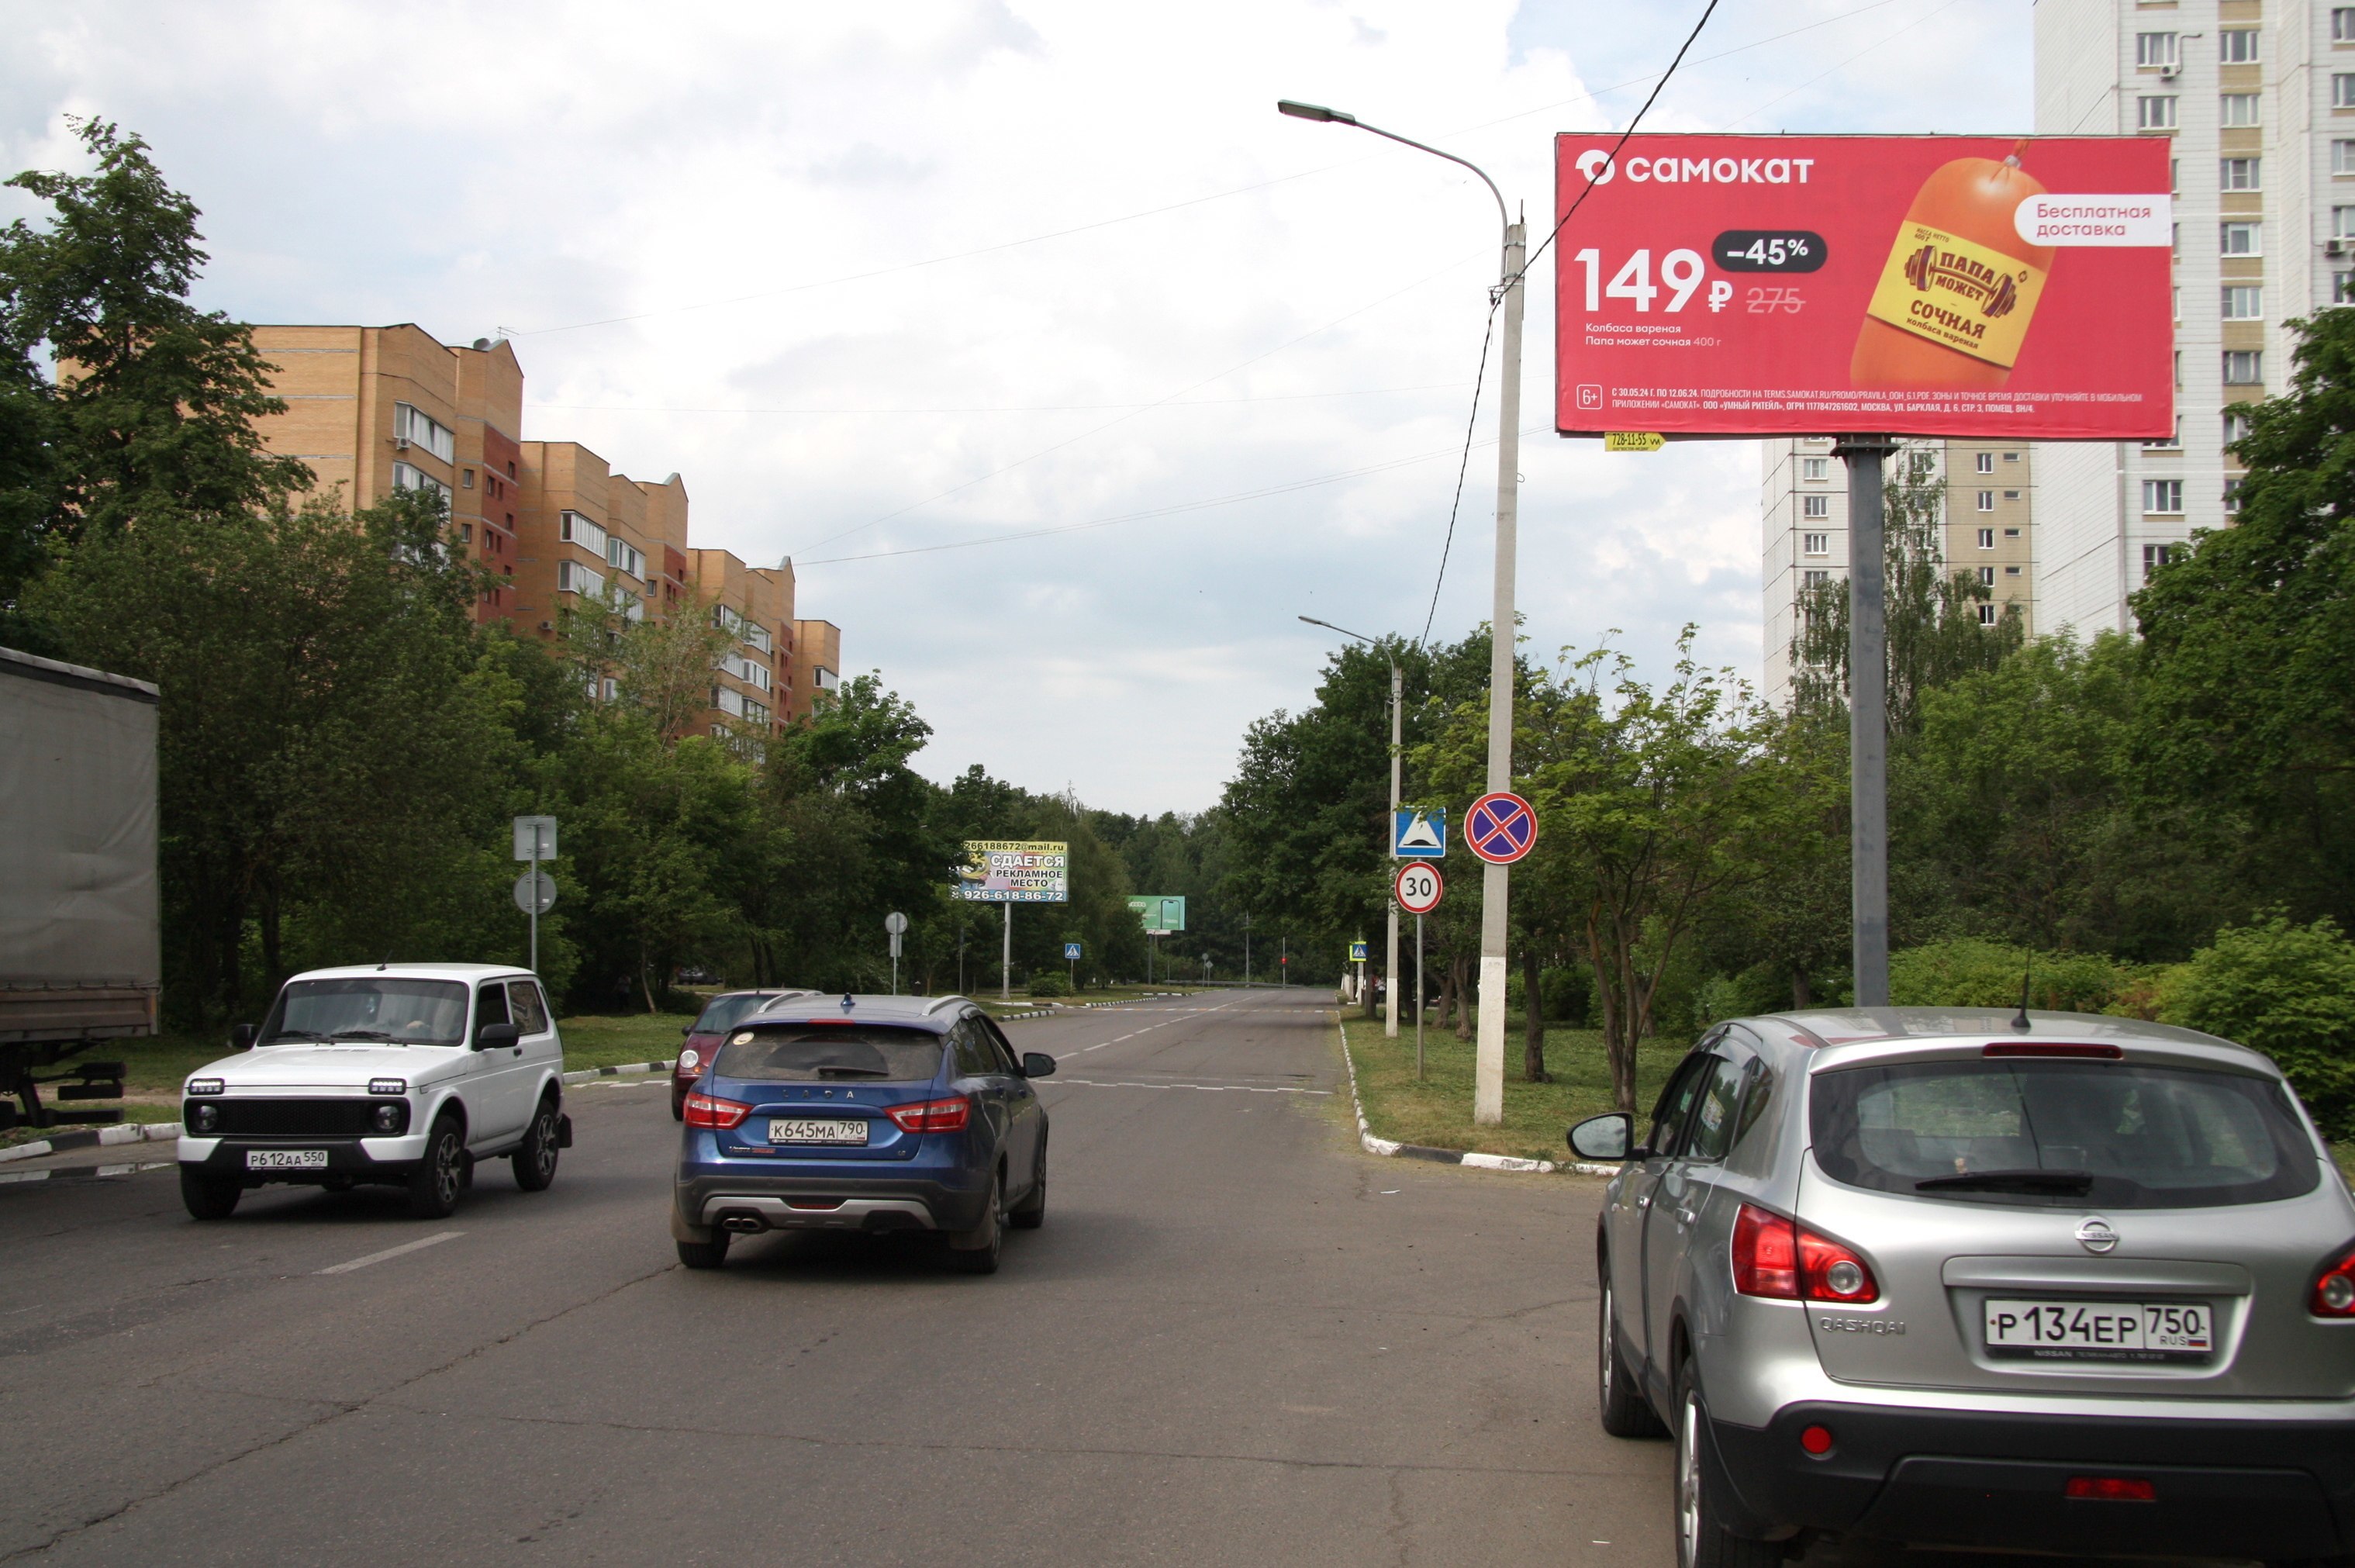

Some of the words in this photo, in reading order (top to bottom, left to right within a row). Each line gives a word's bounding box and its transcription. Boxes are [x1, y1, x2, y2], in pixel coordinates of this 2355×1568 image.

[2037, 203, 2151, 219] Бесплатная
[2036, 223, 2126, 238] доставка
[1939, 252, 1995, 285] ПАПА
[1935, 275, 1984, 302] МОЖЕТ
[1746, 287, 1806, 314] 275
[1911, 299, 1987, 340] СОЧНАЯ
[1585, 323, 1633, 333] Колбаса
[1635, 325, 1681, 334] вареная
[1906, 317, 1942, 336] колбаса
[1942, 331, 1979, 350] вареная
[1585, 336, 1614, 346] Папа
[1617, 337, 1650, 346] может
[1652, 338, 1691, 347] сочная
[1693, 337, 1714, 347] 400
[1582, 389, 1598, 405] 6+
[1611, 388, 1617, 396] С
[1618, 388, 1649, 397] 30.05.24
[1656, 389, 1667, 397] ПО
[1669, 389, 1699, 398] 12.06.24.
[1701, 389, 1751, 399] ПОДРОБНОСТИ
[1752, 390, 1763, 399] НА
[1932, 392, 1953, 400] ЗОНЫ
[1953, 392, 1960, 400] И
[1961, 392, 1987, 401] ТОЧНОЕ
[1988, 392, 2011, 401] ВРЕМЯ
[2012, 392, 2049, 402] ДОСТАВКИ
[2051, 392, 2088, 402] УТОЧНЯЙТЕ
[2090, 393, 2096, 402] В
[2097, 393, 2143, 402] МОБИЛЬНОМ
[1612, 399, 1659, 409] ПРИЛОЖЕНИИ
[1703, 401, 1718, 409] ООО
[1720, 400, 1750, 410] «УМНЫЙ
[1786, 402, 1804, 410] ОГРН
[1861, 402, 1893, 412] МОСКВА,
[1894, 403, 1904, 413] УЛ.
[1961, 404, 1976, 413] СТР.
[1985, 404, 2014, 413] ПОМЕЩ.
[1612, 433, 1647, 446] 728-11-55
[960, 841, 1064, 851] 266188672@mail.ru
[990, 854, 1065, 869] СДАЕТСЯ
[996, 869, 1063, 879] РЕКЛАМНОЕ
[1010, 879, 1048, 887] МЕСТО
[1405, 877, 1432, 897] 30
[840, 1122, 863, 1135] 790
[304, 1152, 325, 1162] 550
[2080, 1231, 2117, 1240] NISSAN
[1819, 1316, 1906, 1335] QASHQAI
[2146, 1307, 2200, 1335] 750
[2160, 1335, 2187, 1346] RUS
